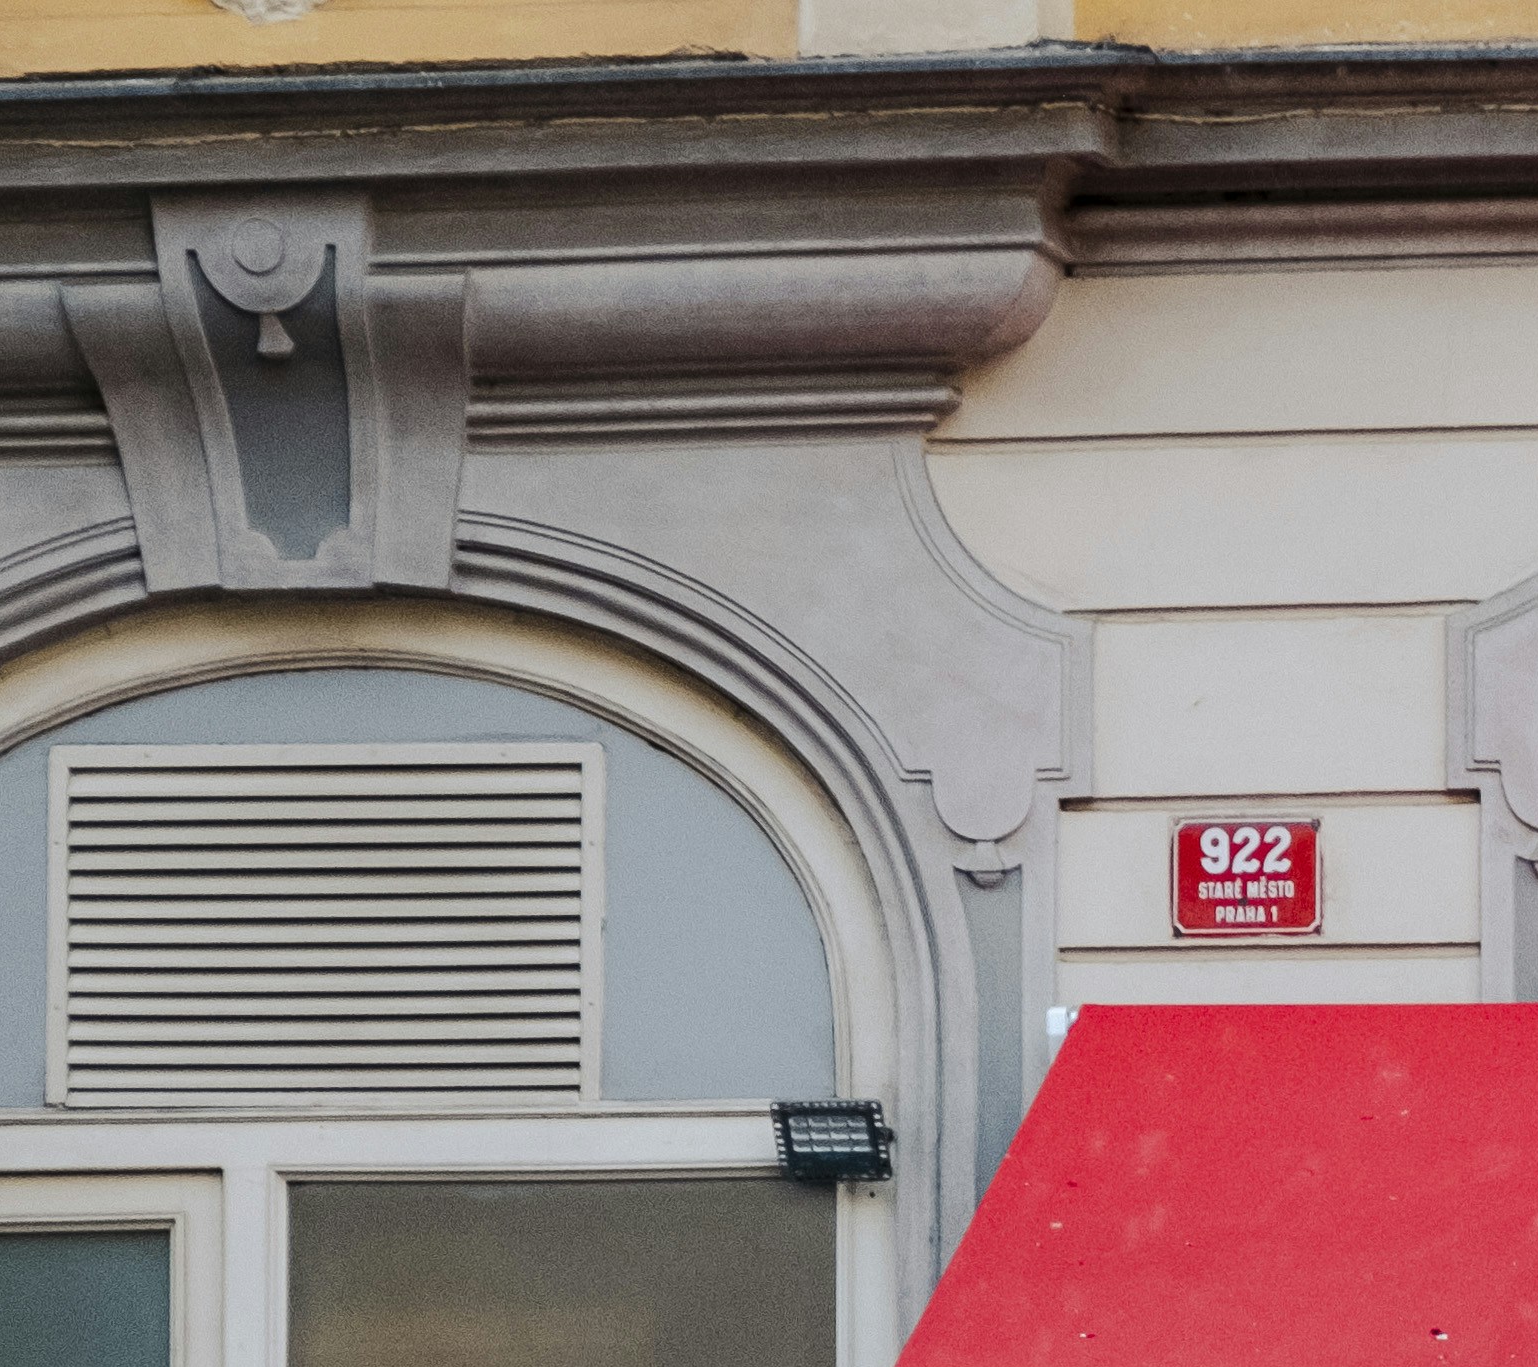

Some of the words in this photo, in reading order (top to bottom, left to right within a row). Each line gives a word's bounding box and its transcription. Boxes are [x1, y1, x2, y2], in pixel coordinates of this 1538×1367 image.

[1200, 826, 1292, 874] 922
[1198, 877, 1243, 899] STARÉ
[1247, 876, 1295, 899] MĚSTO
[1215, 906, 1265, 922] PRAHA
[1270, 906, 1278, 922] 1
